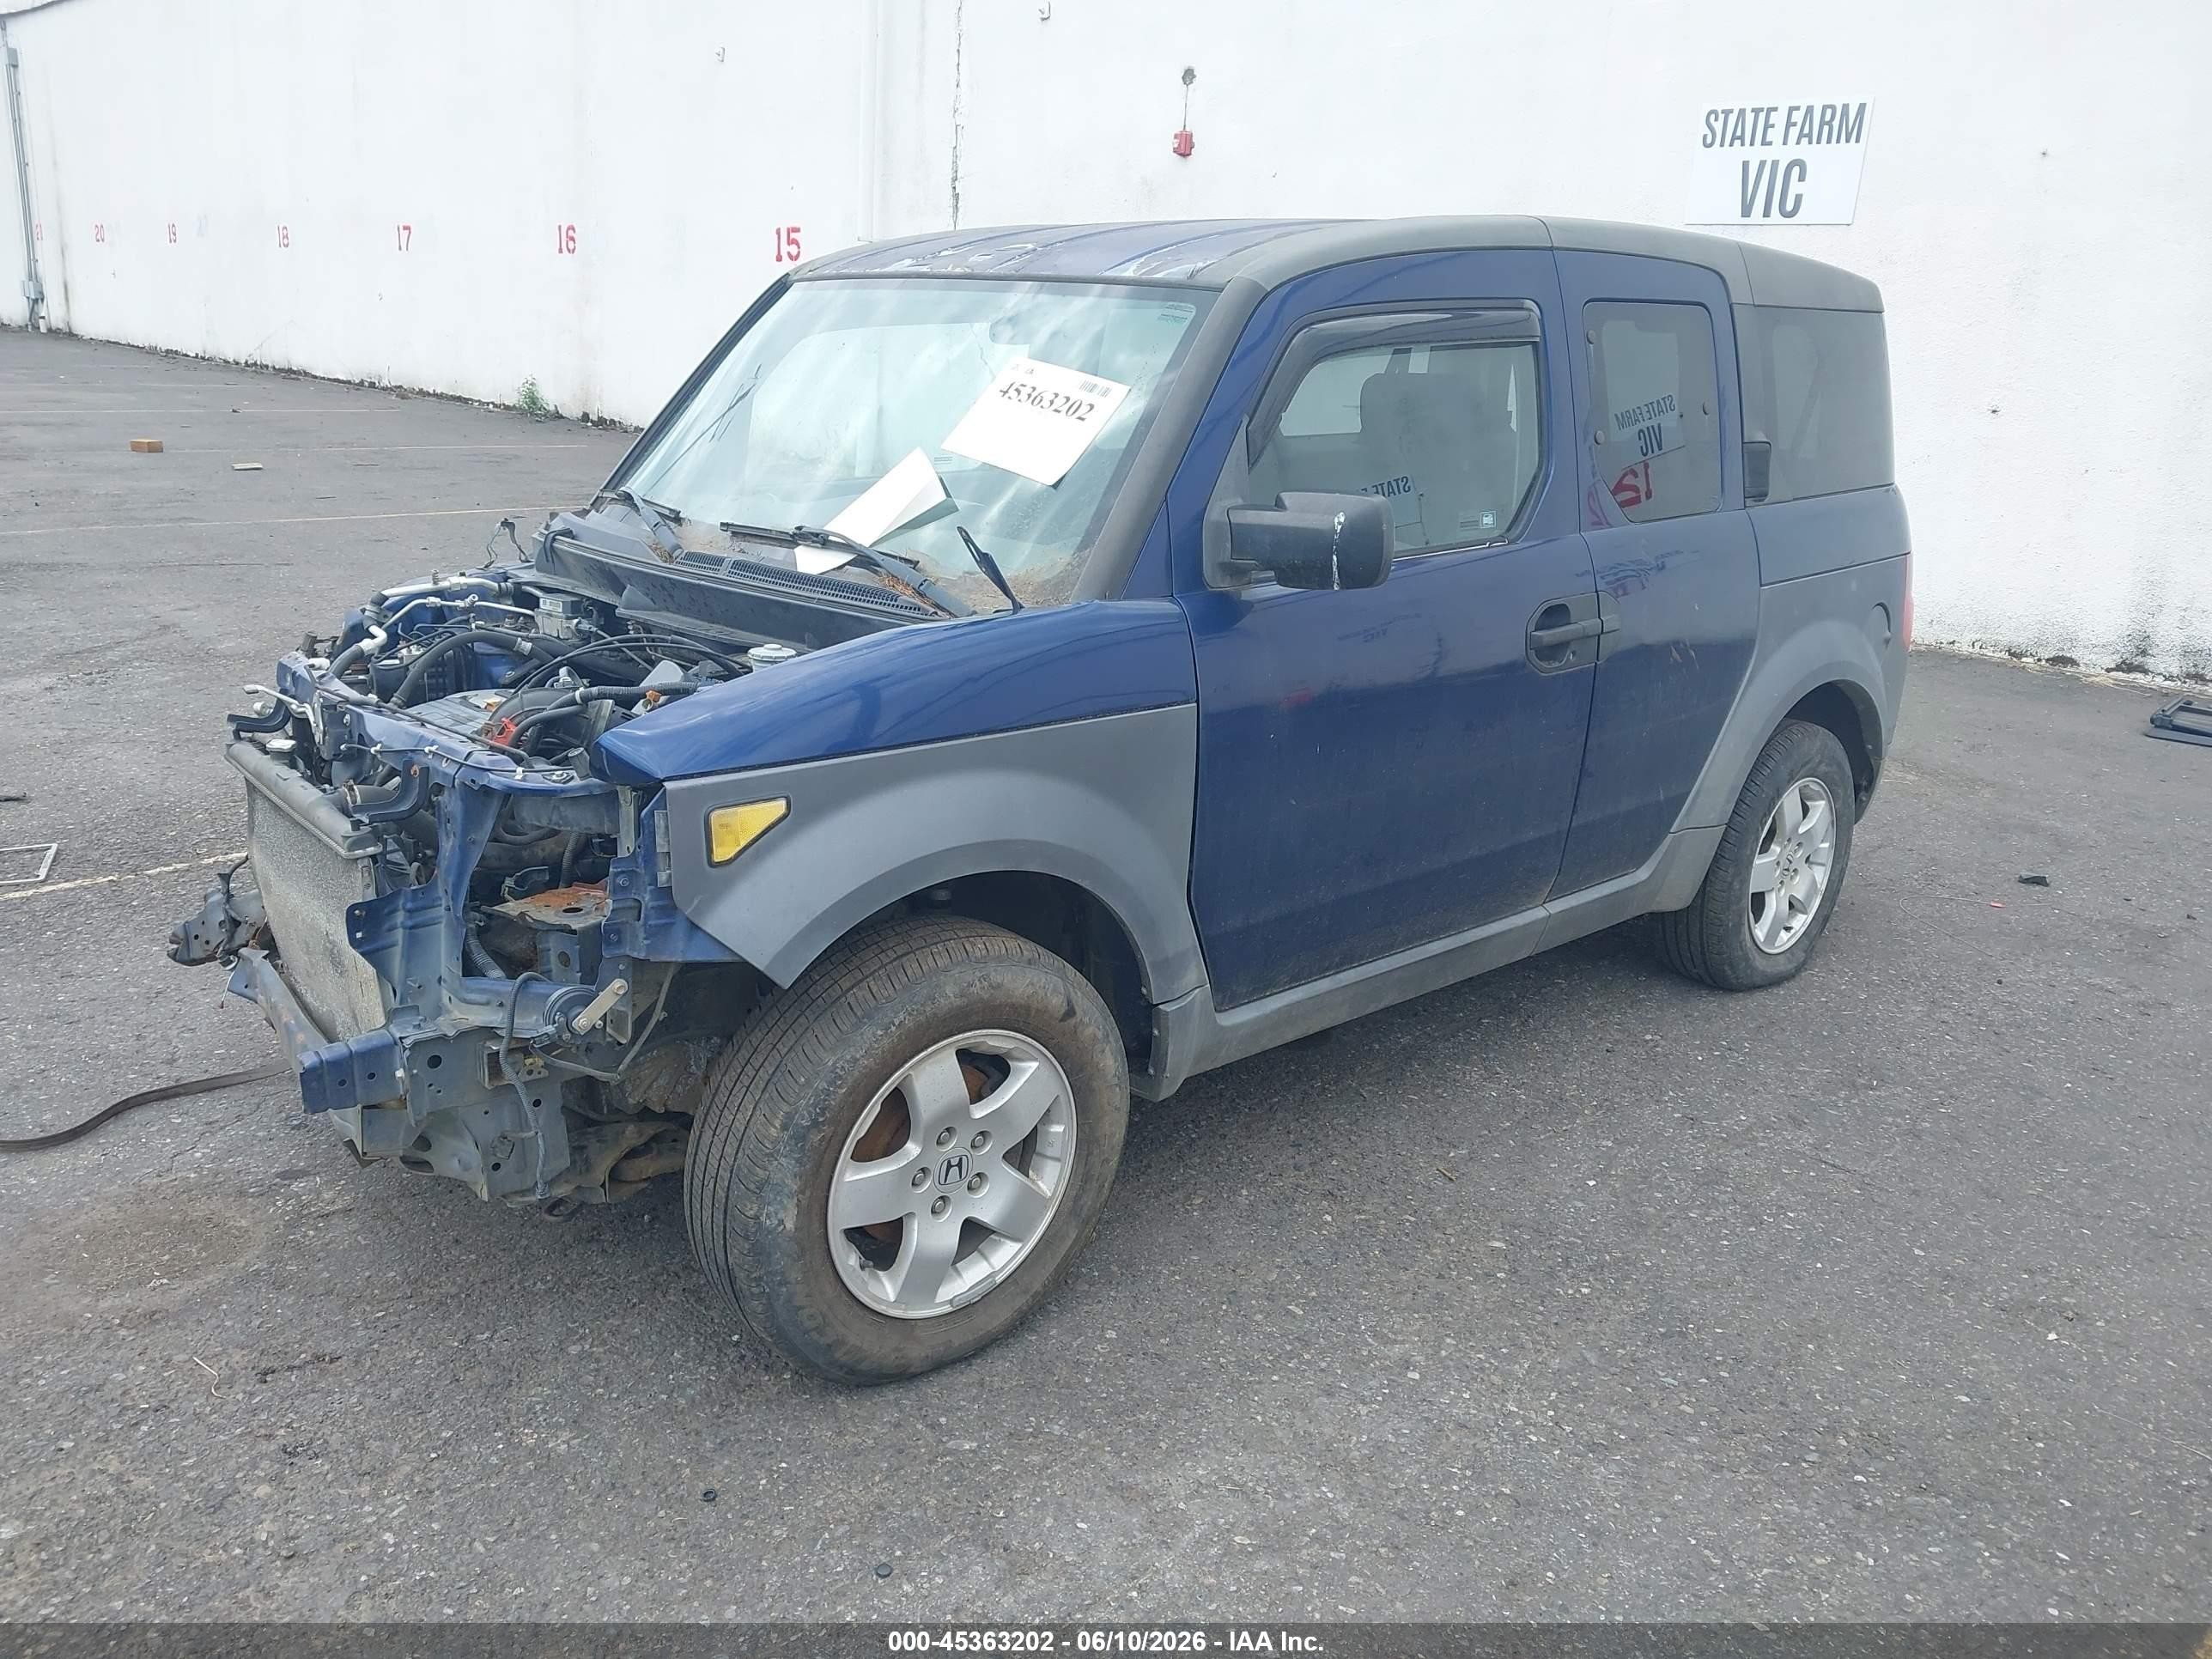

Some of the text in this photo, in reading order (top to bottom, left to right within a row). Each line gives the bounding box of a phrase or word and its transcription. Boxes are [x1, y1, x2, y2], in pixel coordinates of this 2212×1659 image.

[1702, 102, 1867, 149] STATE FARM
[1741, 158, 1808, 218] VIC
[94, 223, 105, 243] 20
[167, 222, 177, 244] 19
[277, 225, 289, 248] 18
[397, 224, 411, 252] 17
[558, 224, 576, 254] 16
[775, 227, 801, 262] 15
[999, 381, 1095, 422] 45363202
